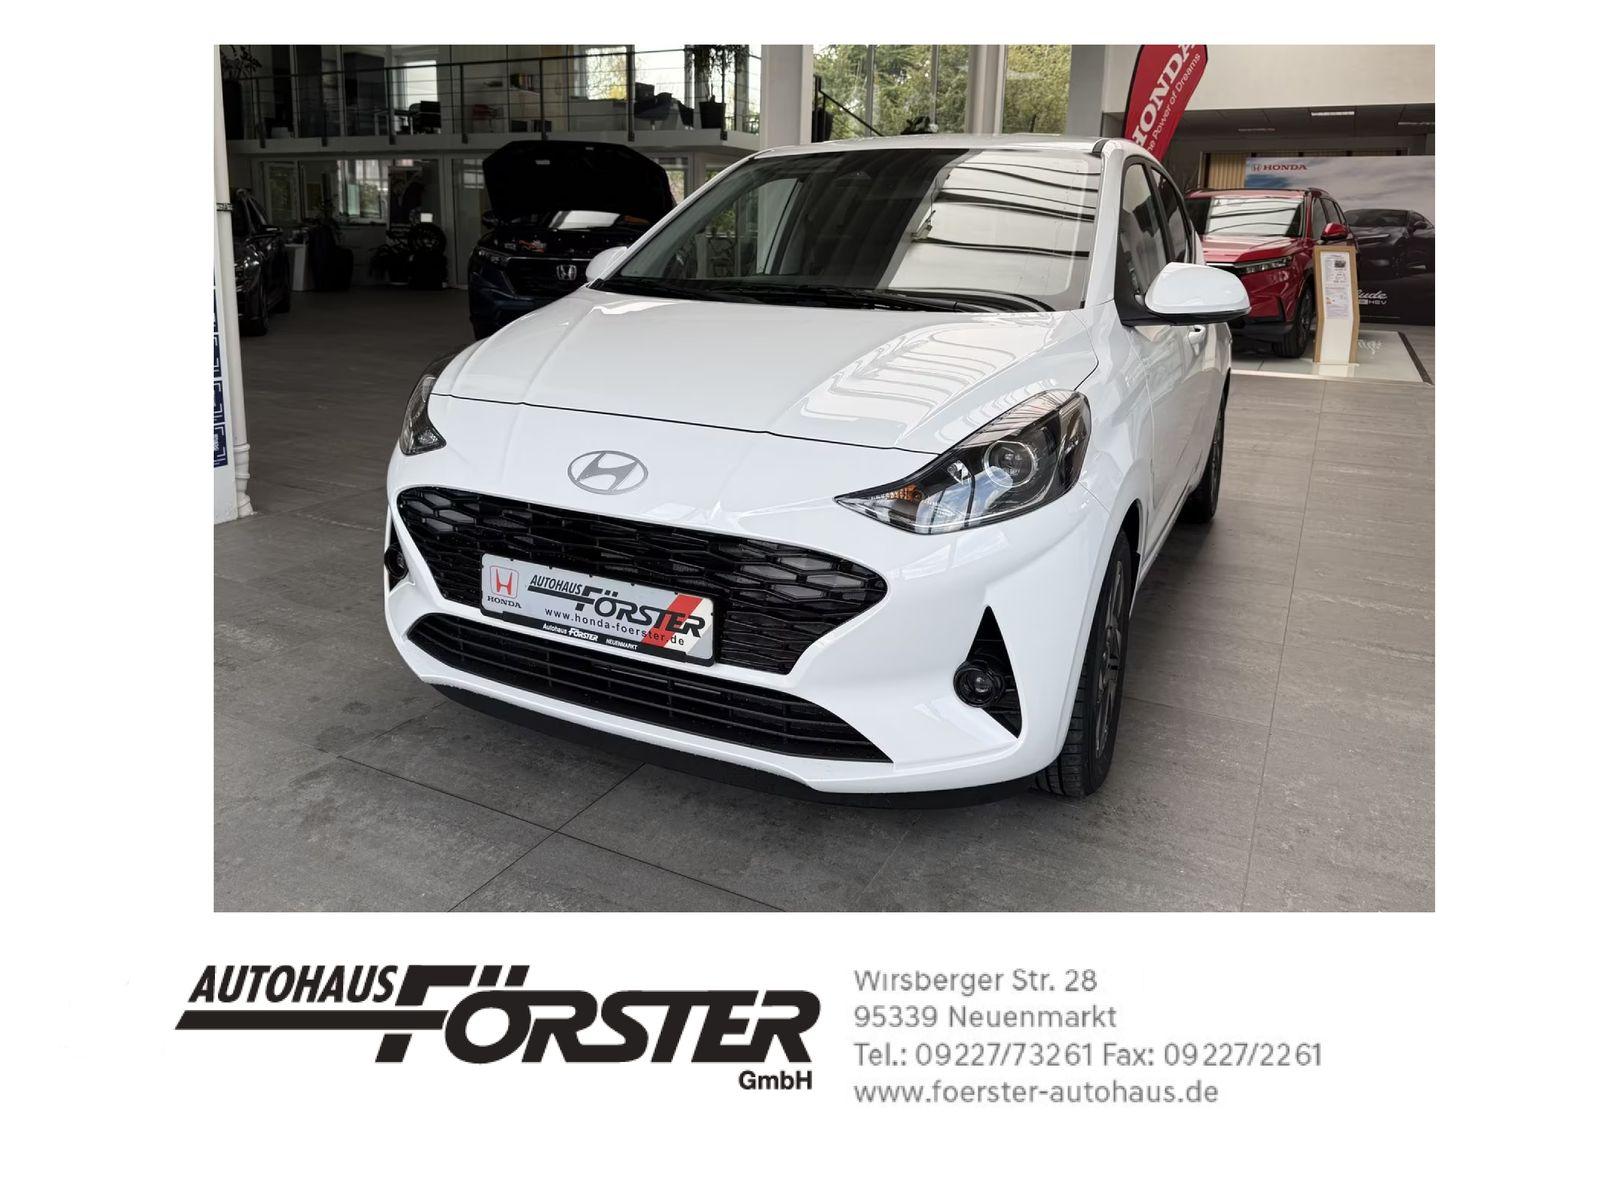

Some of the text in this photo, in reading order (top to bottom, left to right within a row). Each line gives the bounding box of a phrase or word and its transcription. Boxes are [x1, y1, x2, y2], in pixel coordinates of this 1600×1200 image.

[1152, 106, 1172, 140] Power
[1169, 90, 1178, 105] of
[1175, 53, 1201, 92] Dreams
[487, 595, 522, 609] HONDA
[530, 574, 706, 638] AUTOHAUS FÖRSTER
[542, 622, 568, 635] Autohaus
[544, 607, 685, 646] www.honda-foerster.de
